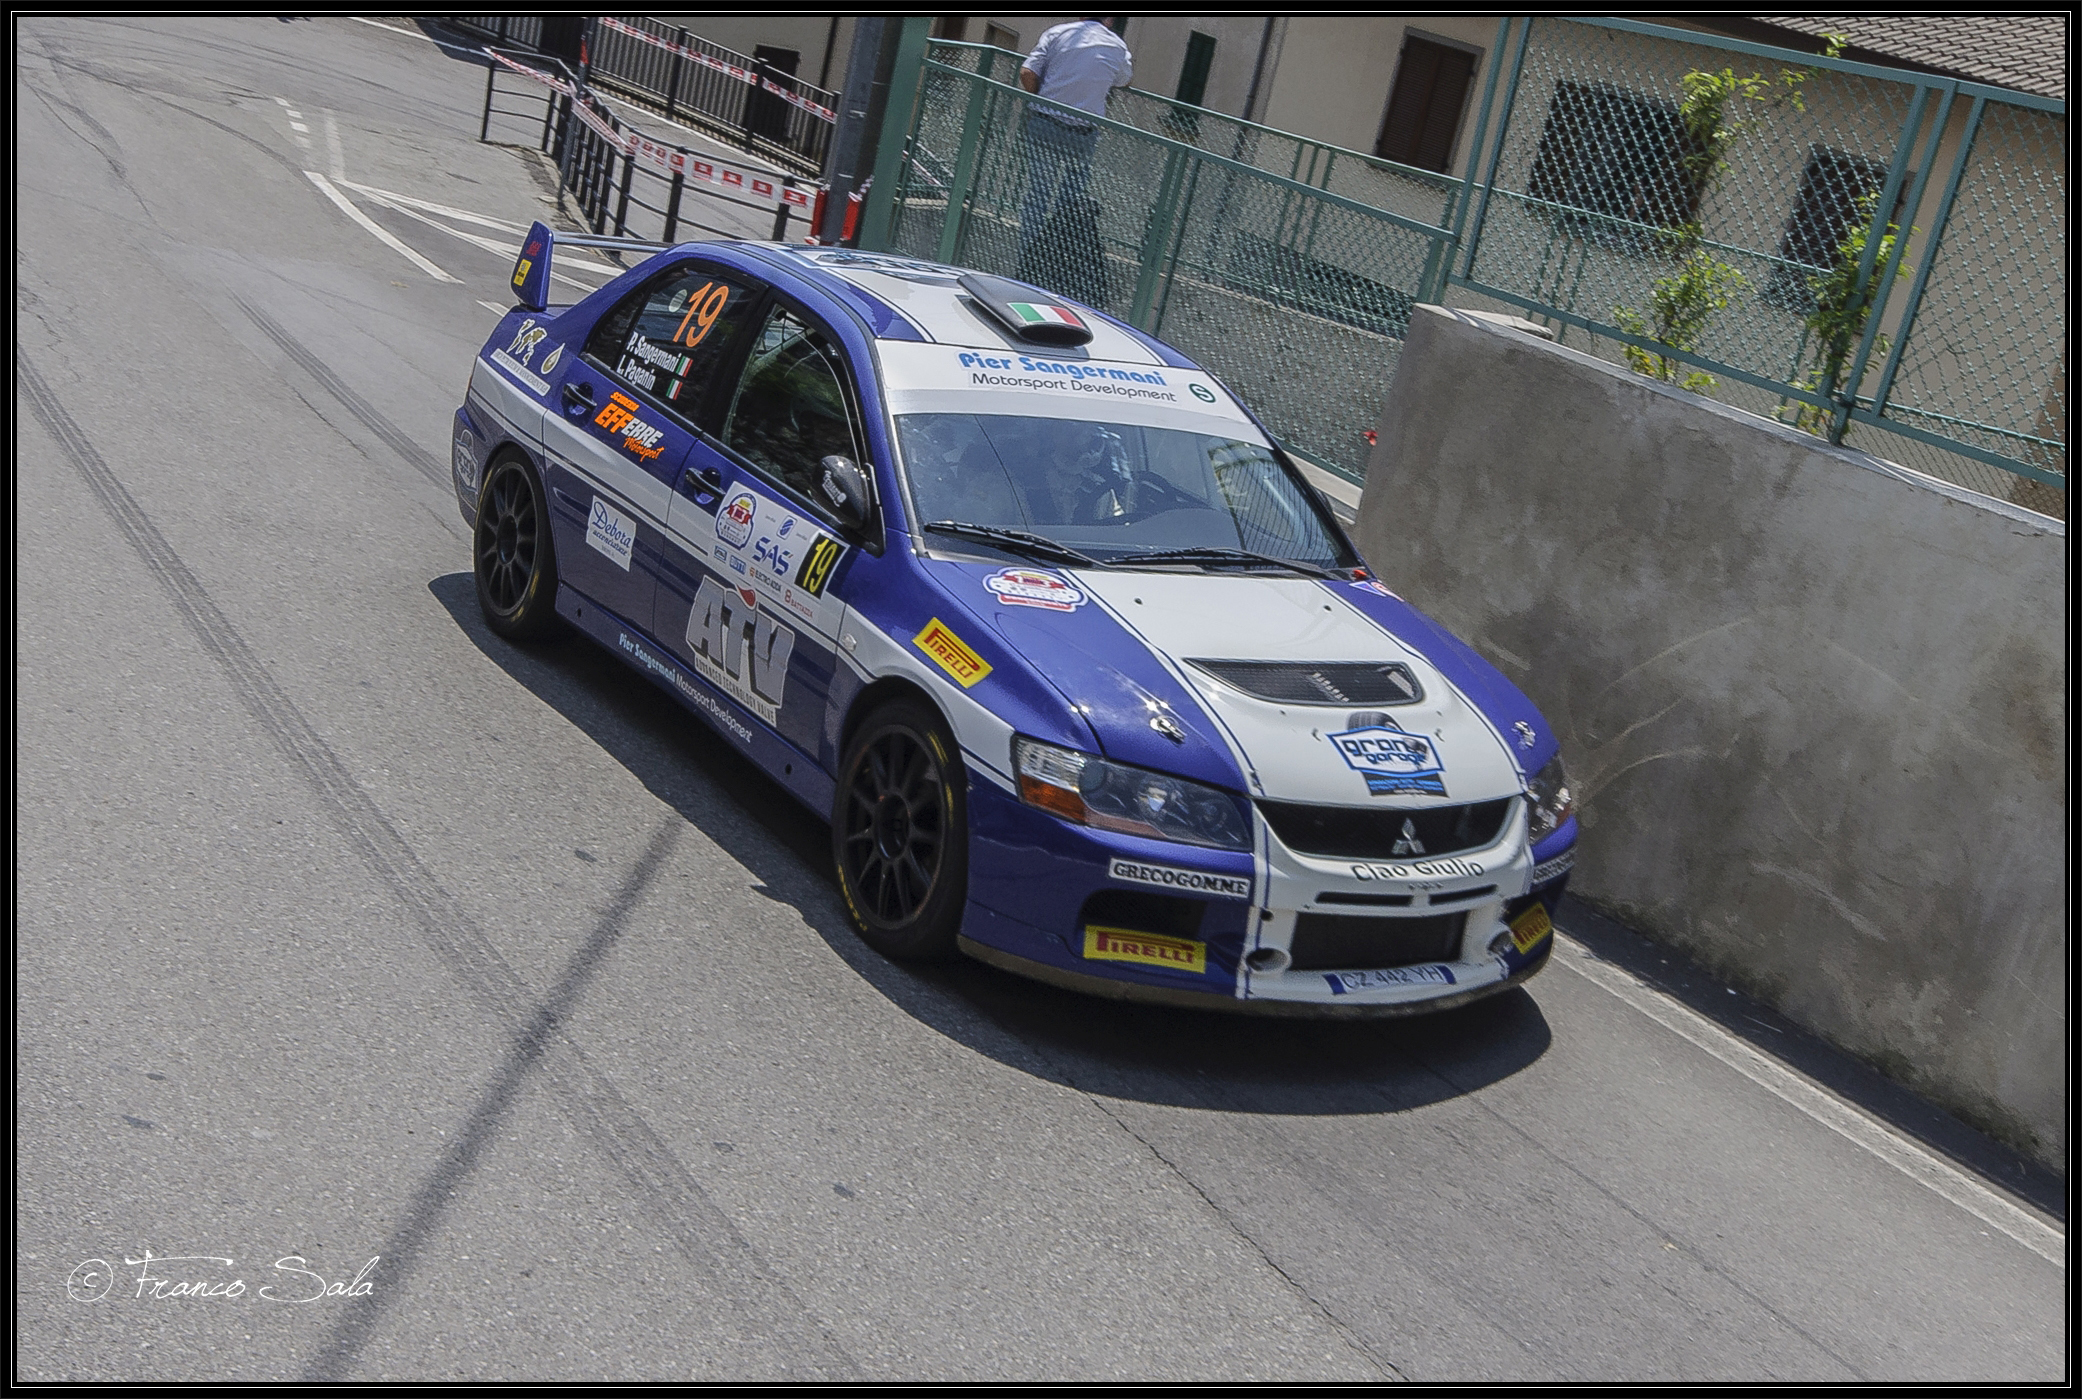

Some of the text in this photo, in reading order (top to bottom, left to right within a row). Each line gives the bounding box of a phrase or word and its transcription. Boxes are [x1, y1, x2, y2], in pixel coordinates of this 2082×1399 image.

[672, 281, 729, 348] 19
[616, 354, 656, 391] L. Paganin
[626, 331, 682, 374] P. Sangermani
[958, 352, 1168, 386] Pier Sangermani
[972, 373, 1177, 402] Motorsport Development
[594, 402, 664, 448] EFFERRE
[591, 501, 632, 548] Debora
[752, 536, 790, 576] SAS
[802, 538, 838, 593] 19
[686, 576, 795, 708] ATV
[923, 627, 981, 679] PIRELLI
[619, 633, 753, 743] Pier Sangermani Motorsport Development
[1352, 859, 1485, 881] Ciao Giulio
[1096, 931, 1195, 965] PIRELLI
